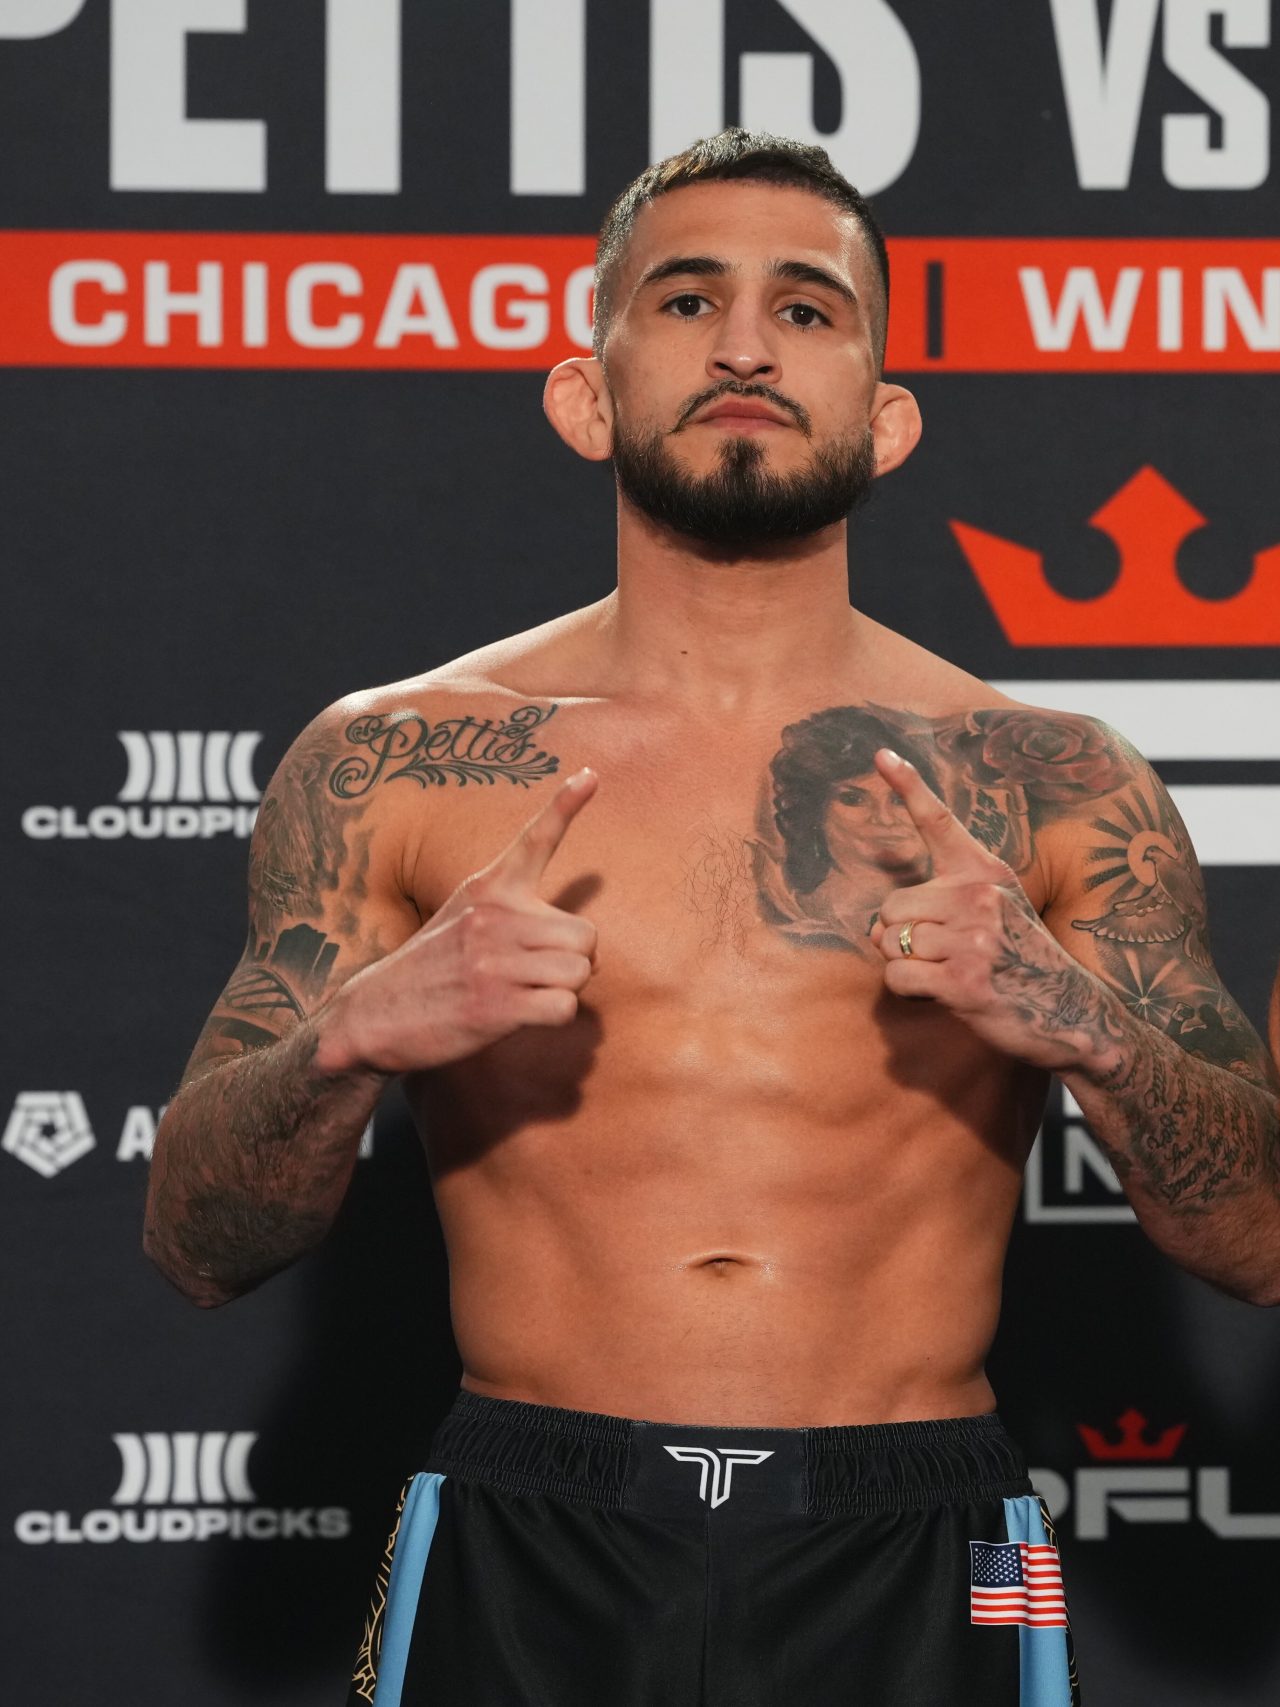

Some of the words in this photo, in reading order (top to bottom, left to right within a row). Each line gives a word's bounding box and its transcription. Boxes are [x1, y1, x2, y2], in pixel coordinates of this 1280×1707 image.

[329, 704, 558, 799] Pettis
[21, 806, 260, 839] CLOUDPI
[15, 1508, 350, 1544] CLOUDPICKS
